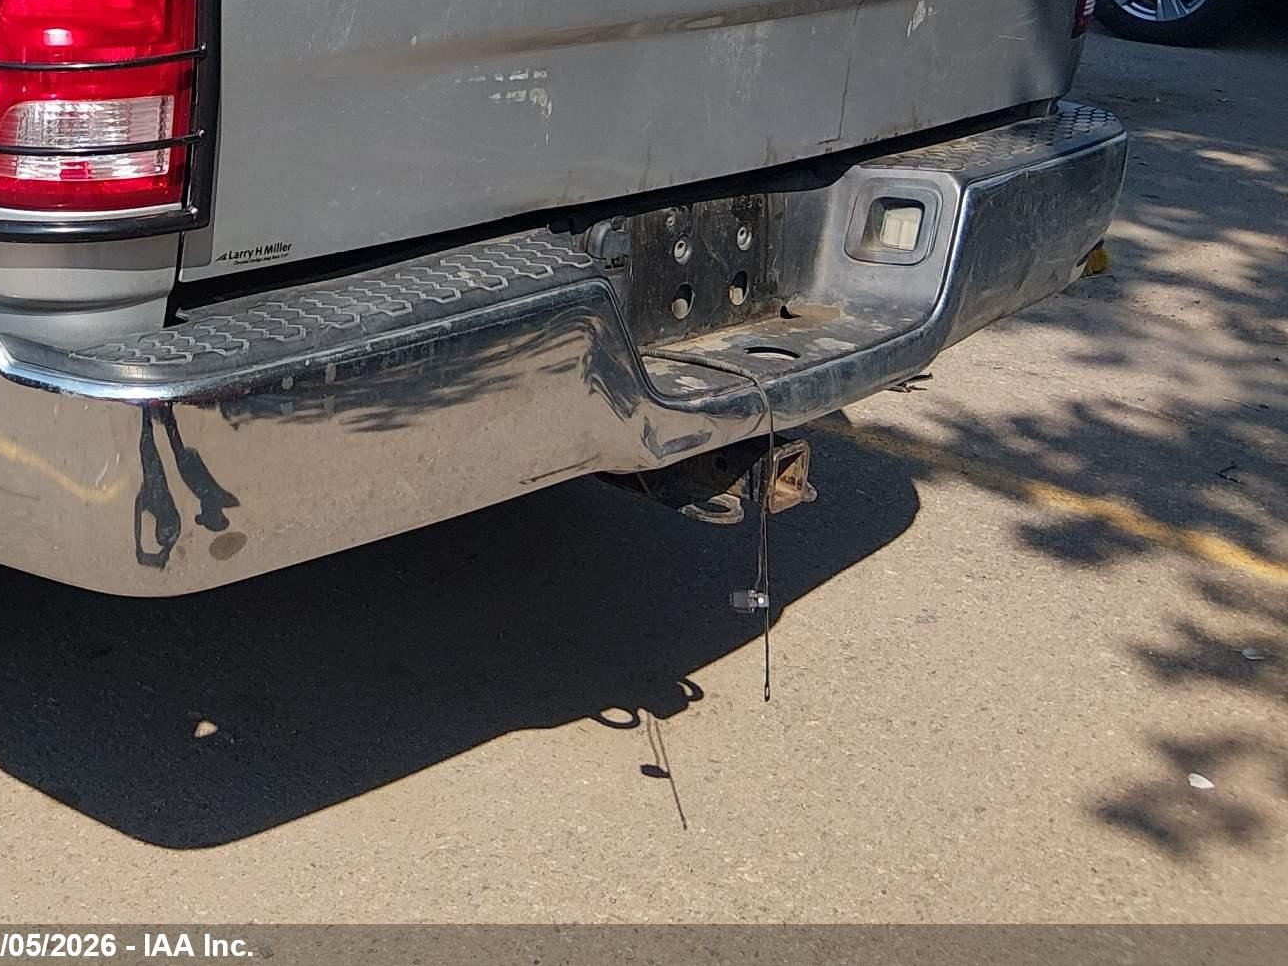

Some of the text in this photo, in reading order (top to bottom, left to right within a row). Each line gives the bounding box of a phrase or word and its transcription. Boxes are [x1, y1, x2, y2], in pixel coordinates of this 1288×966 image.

[229, 248, 254, 260] Larry
[255, 246, 263, 256] H
[264, 241, 292, 254] Miller
